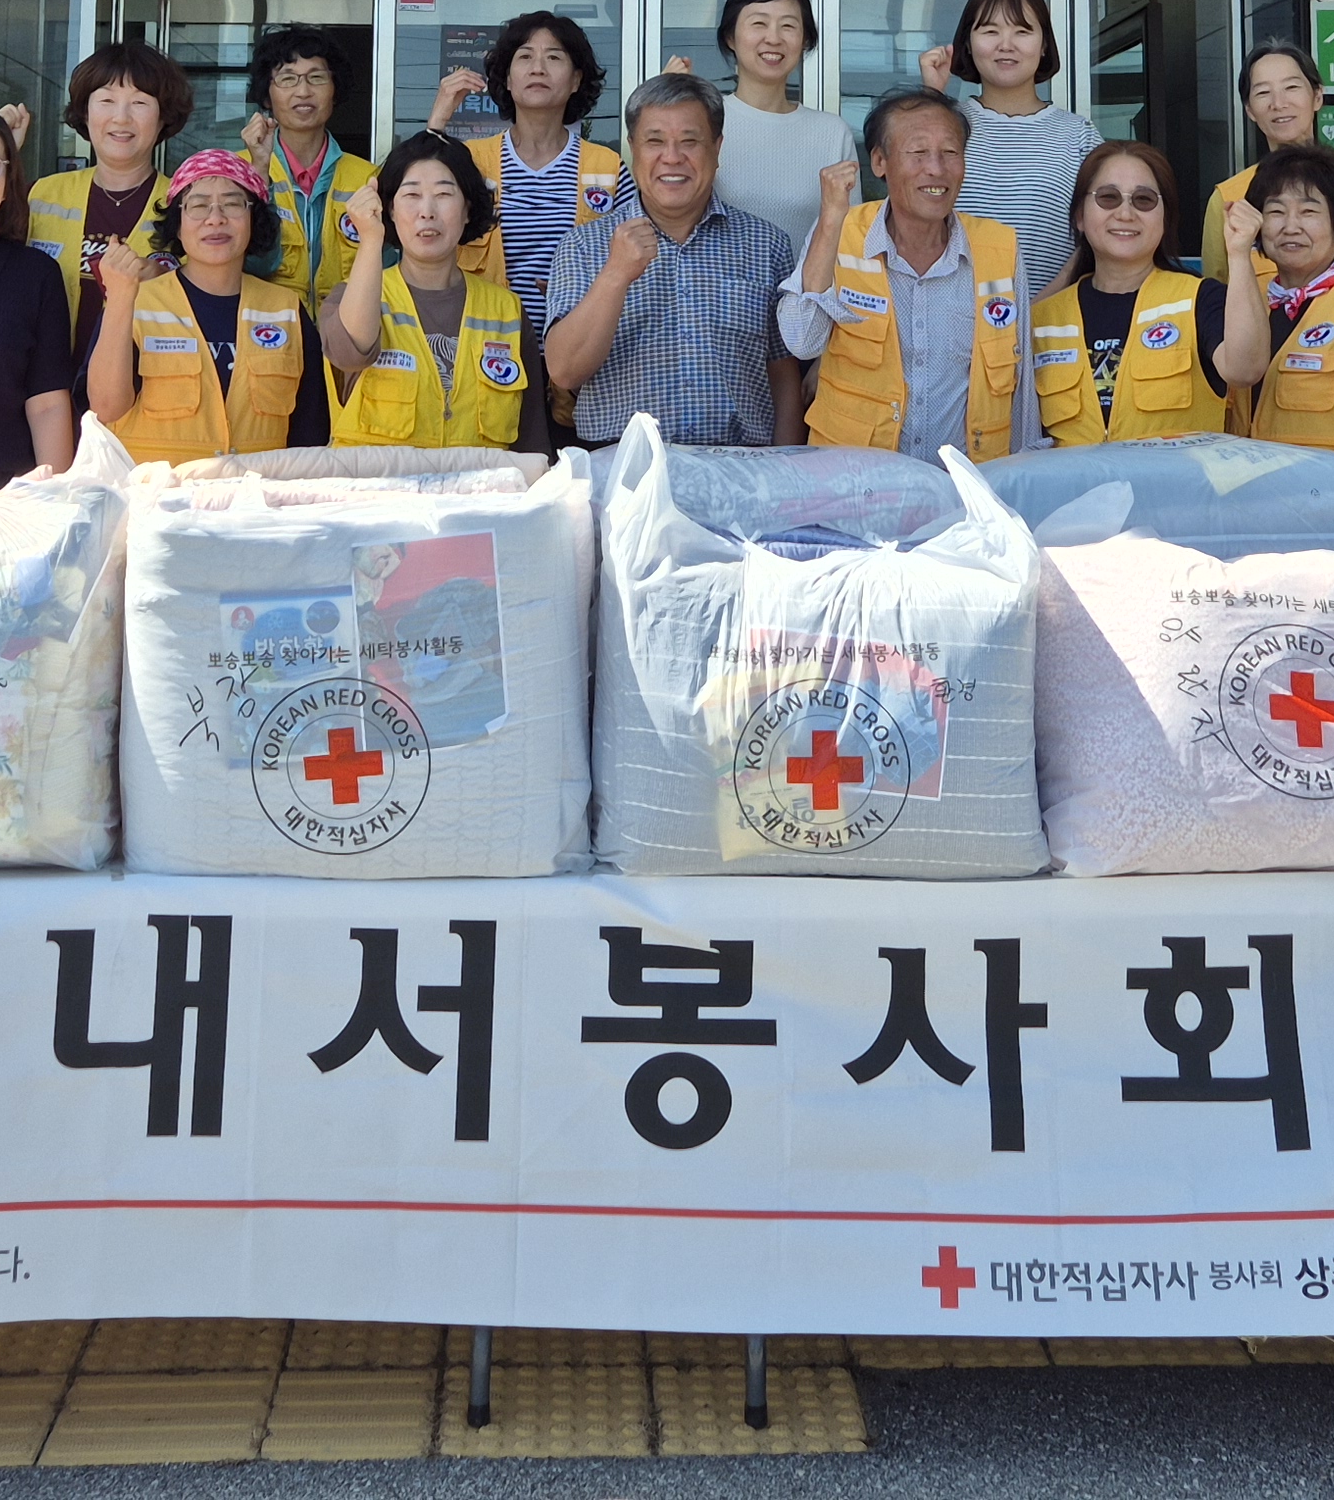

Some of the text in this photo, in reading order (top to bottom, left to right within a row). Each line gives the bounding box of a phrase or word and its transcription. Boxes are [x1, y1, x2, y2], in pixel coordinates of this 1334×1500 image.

[1094, 339, 1120, 351] OFF
[1169, 588, 1238, 607] 뽀송뽀송
[1242, 590, 1307, 612] 찾아가는
[207, 635, 465, 670] 뽀송뽀송 찾아가는 세탁봉사활동
[769, 642, 836, 664] 찾아가는
[1228, 635, 1282, 706] KOREAN
[1284, 633, 1325, 656] RED
[261, 688, 420, 771] KOREAN RED CROSS
[744, 689, 900, 771] KOREAN RED CROSS
[283, 799, 408, 847] 대한적십자사
[762, 807, 885, 849] 대한적십자사
[45, 911, 1313, 1153] 내서봉사회
[988, 1257, 1200, 1303] 대한적십자사
[1208, 1259, 1284, 1291] 봉사회
